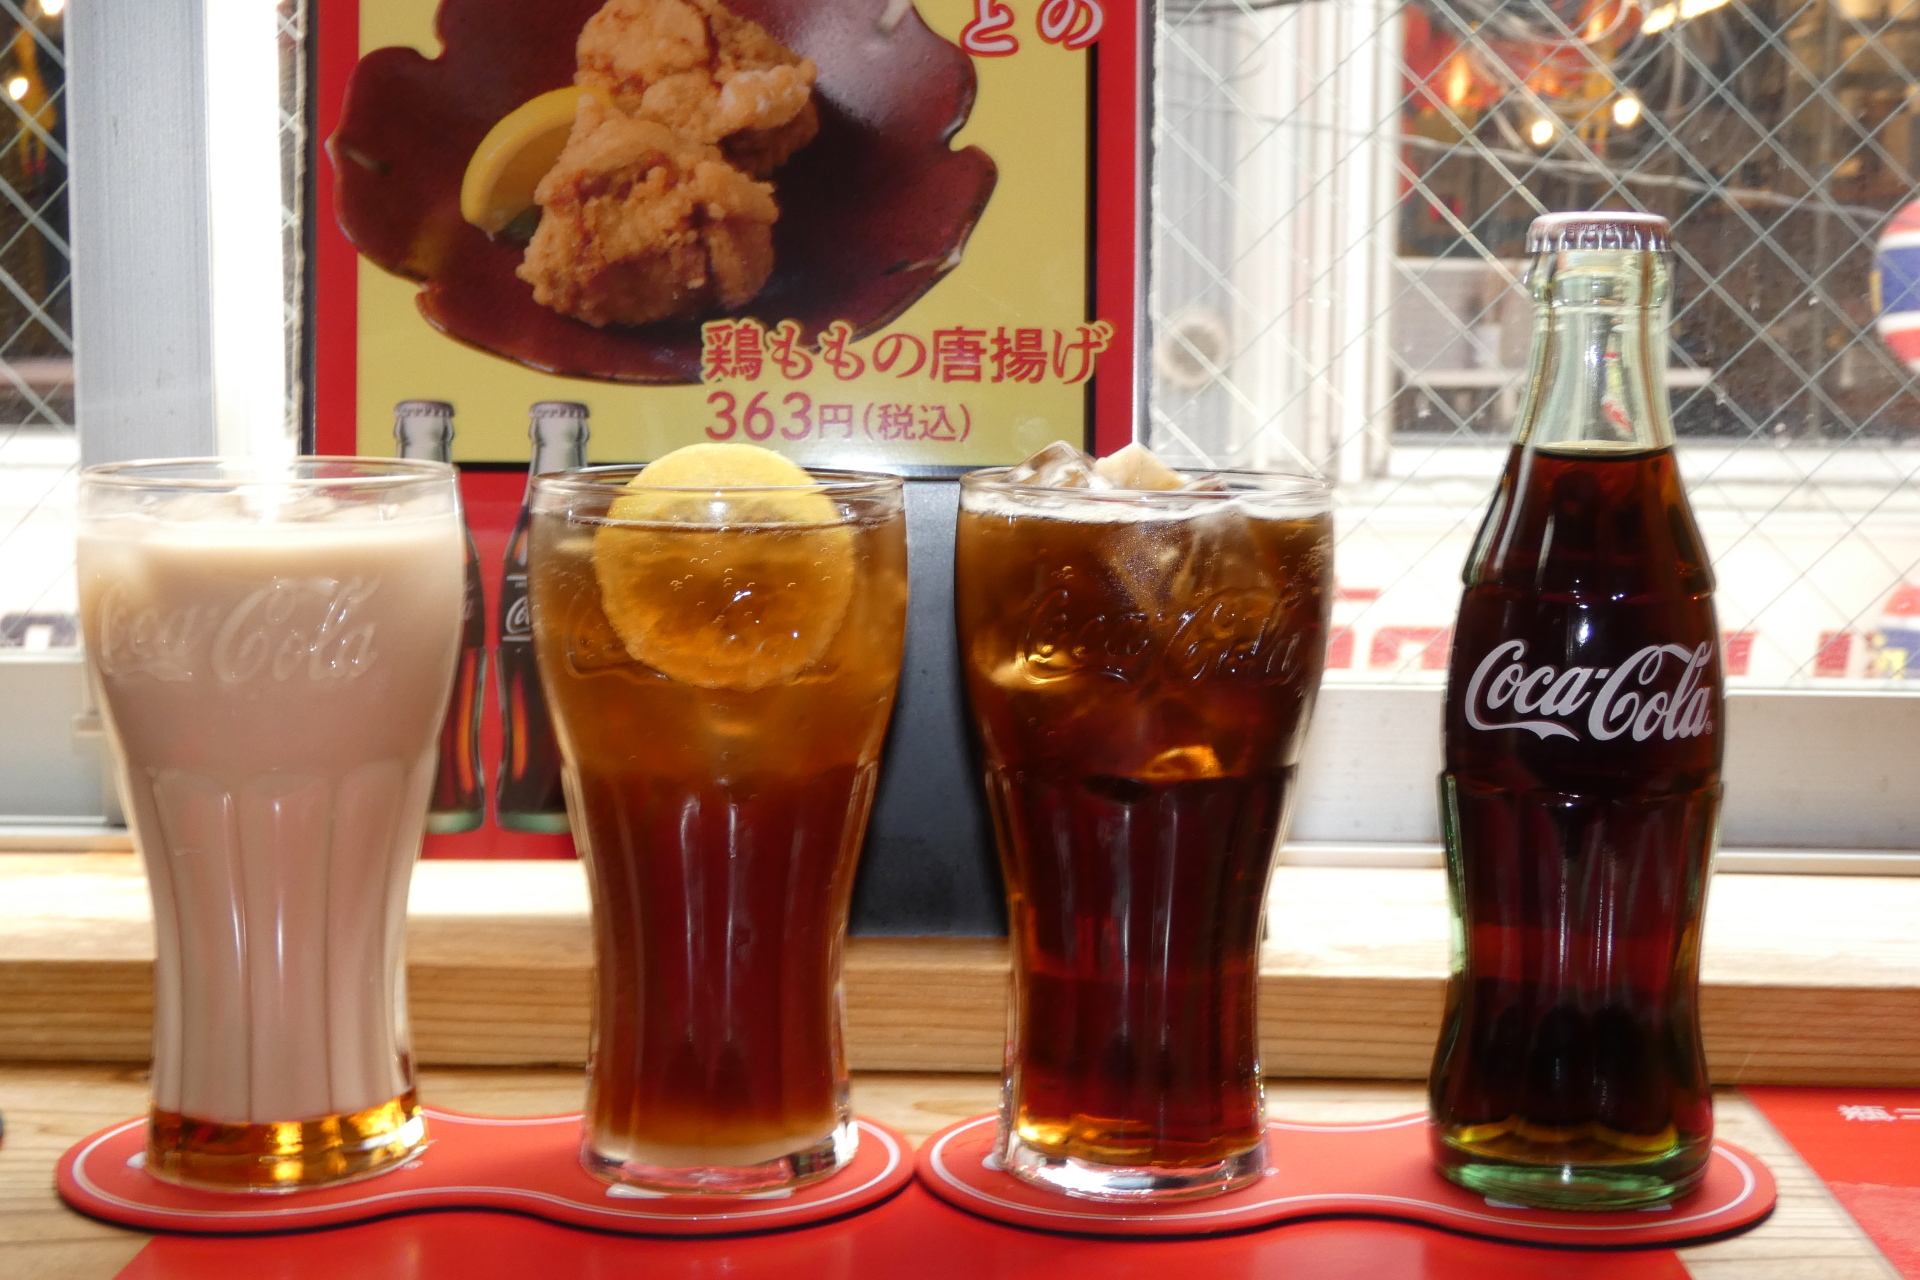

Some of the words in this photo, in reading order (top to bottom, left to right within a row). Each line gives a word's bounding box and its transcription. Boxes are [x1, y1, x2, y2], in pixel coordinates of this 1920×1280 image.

[703, 321, 1115, 385] 鶏ももの唐揚げ
[704, 390, 971, 442] 363円(税込)
[1464, 638, 1713, 742] Coca-Cola
